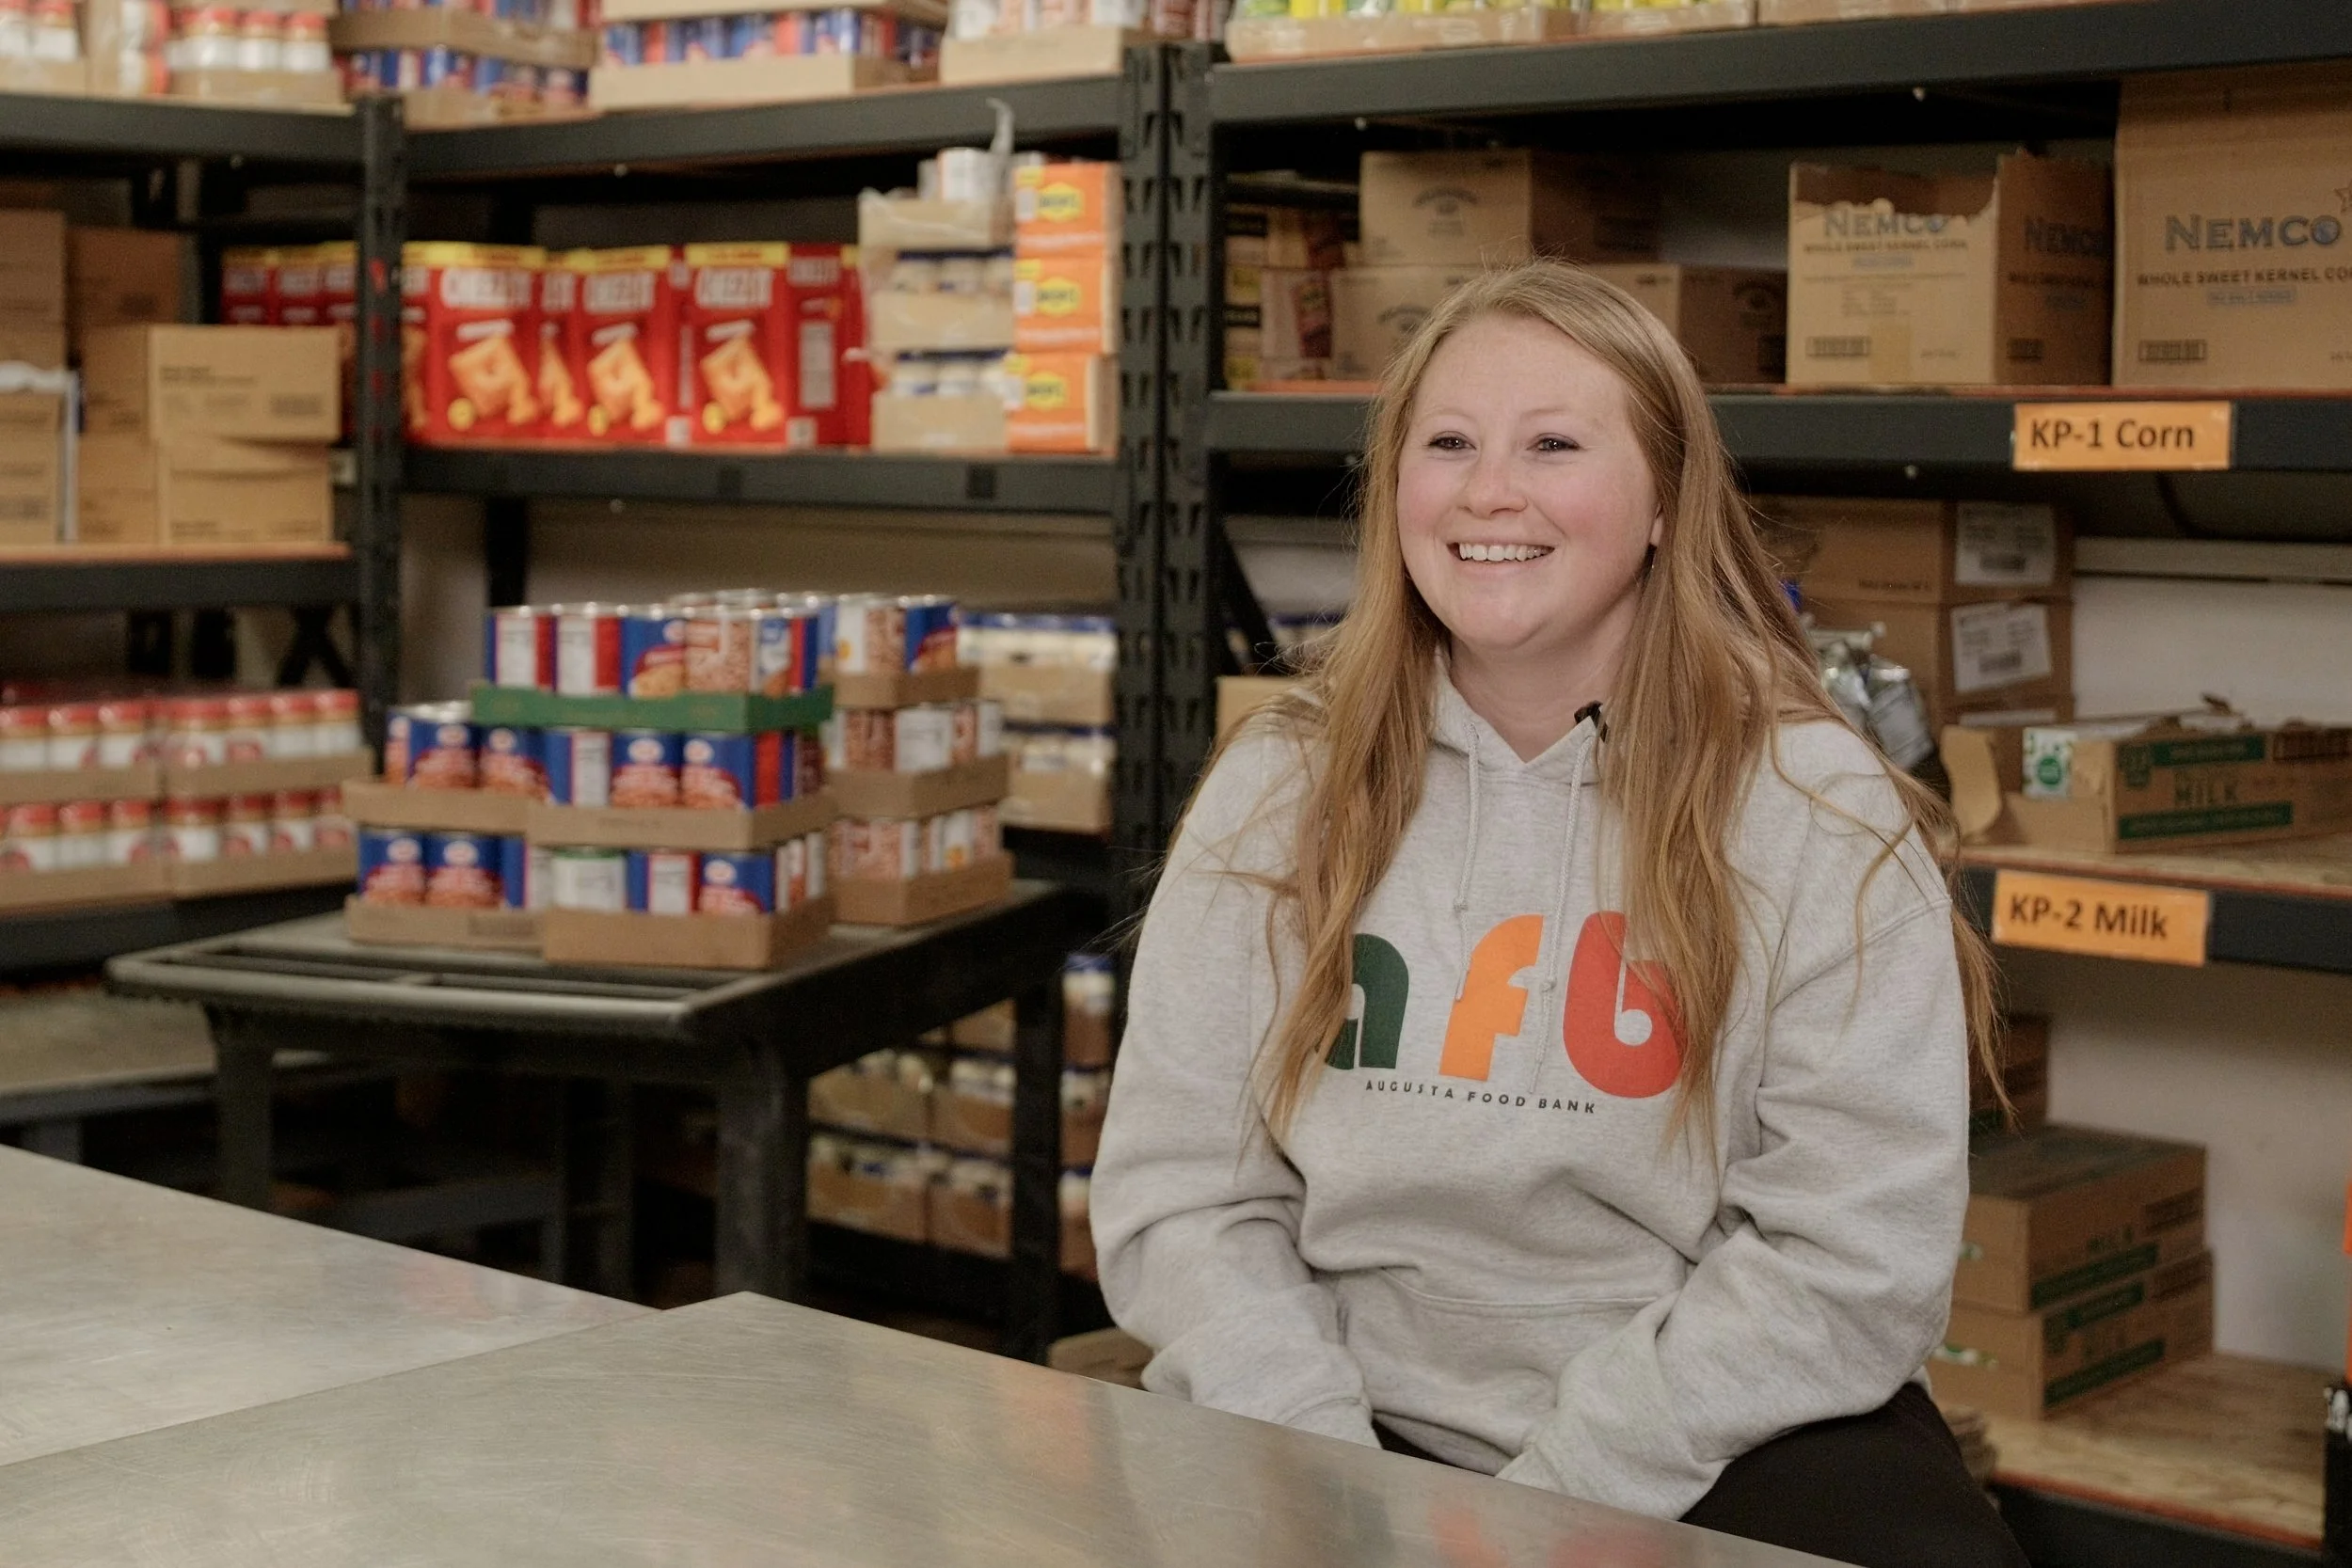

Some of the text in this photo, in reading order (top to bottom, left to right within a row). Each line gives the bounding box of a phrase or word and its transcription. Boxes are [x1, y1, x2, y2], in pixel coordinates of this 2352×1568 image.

[2164, 214, 2342, 252] NEMCO
[2196, 268, 2250, 284] SWEET
[2254, 267, 2321, 282] KERNEL
[2324, 265, 2352, 281] CO
[2031, 418, 2195, 449] KP-1 Corn
[2009, 895, 2169, 940] KP-2 Milk
[1364, 1079, 1597, 1115] AUGUSTA FOOD BANK
